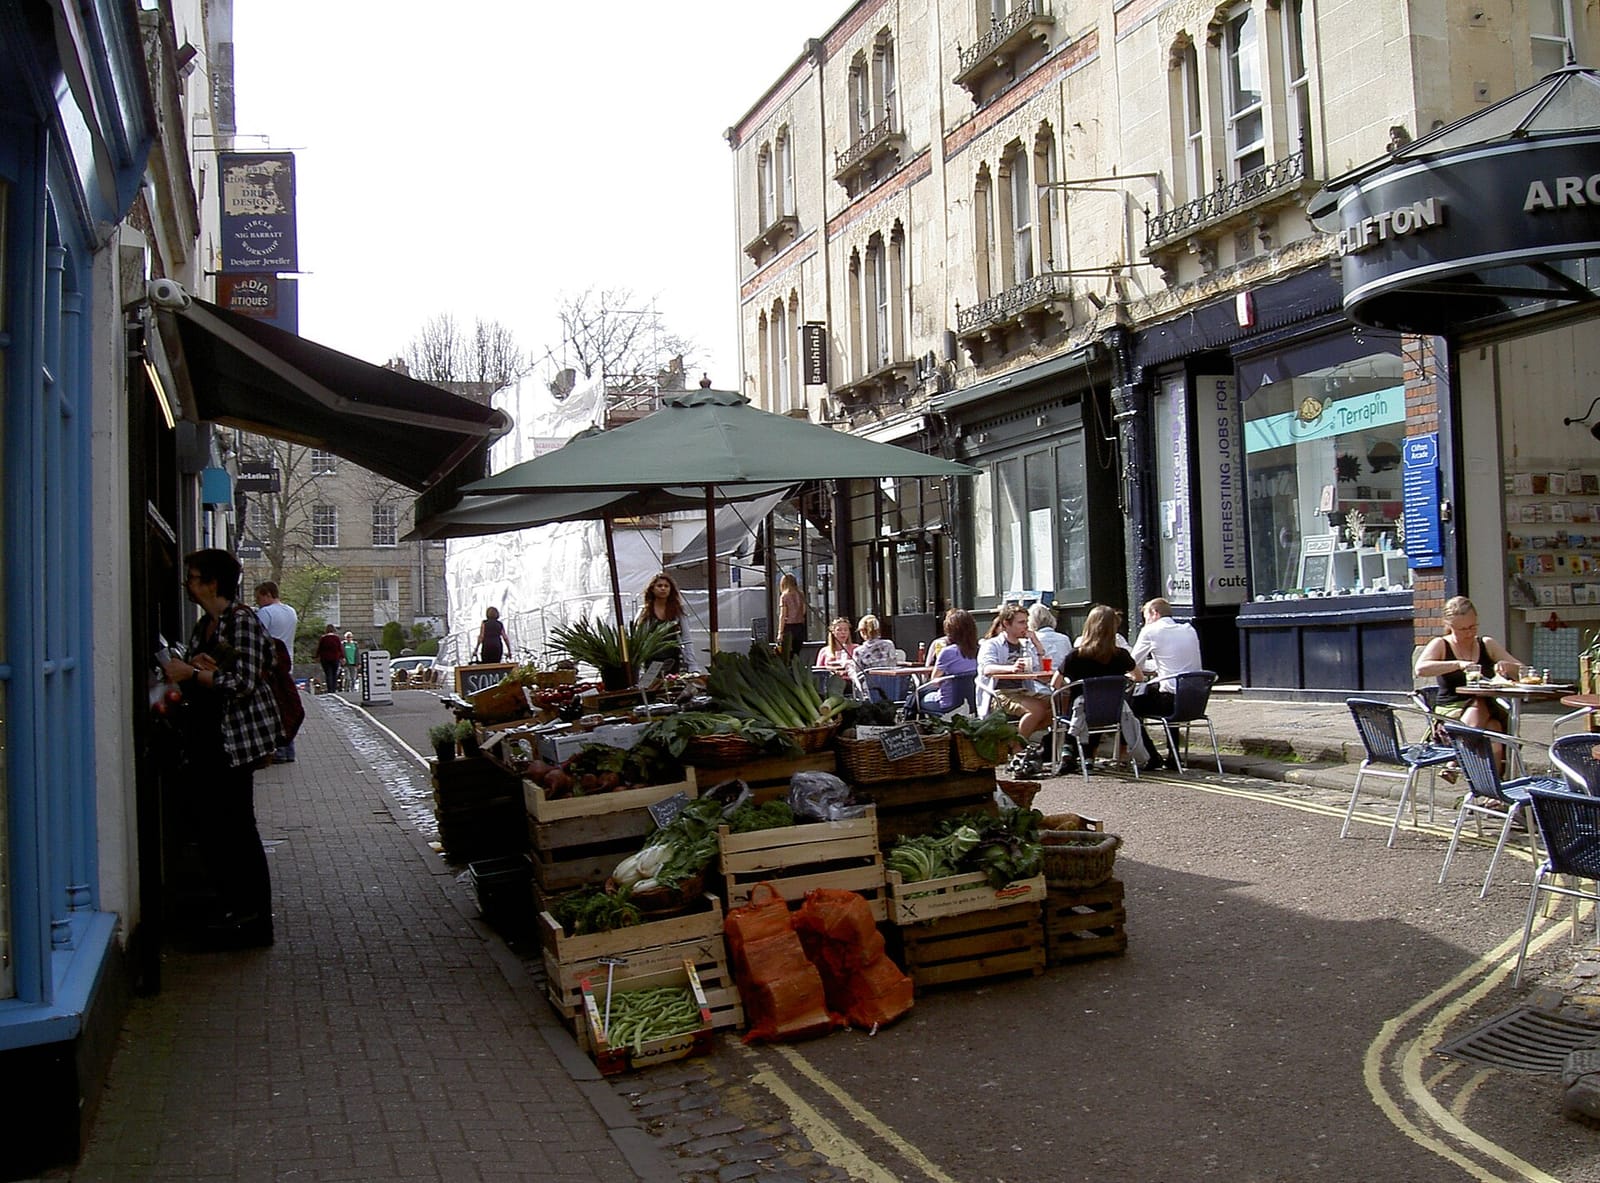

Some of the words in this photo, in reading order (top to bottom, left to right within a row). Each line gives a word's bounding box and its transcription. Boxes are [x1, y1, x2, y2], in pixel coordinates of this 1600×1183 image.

[243, 219, 274, 231] CIRCLE
[1336, 197, 1441, 257] CLIFTON
[241, 240, 279, 256] WORKSHOP
[230, 258, 261, 266] Designer
[262, 257, 291, 266] Jeweller
[810, 328, 821, 383] Bauhinia
[1216, 380, 1228, 411] FOR
[1336, 393, 1388, 428] Terrapin
[1217, 417, 1230, 458] JOBS
[1410, 444, 1428, 452] Clifton
[1411, 451, 1429, 459] Arcade
[1220, 463, 1235, 569] INTERESTING
[1171, 577, 1190, 590] cute
[1218, 575, 1247, 587] cute
[467, 671, 508, 694] SOM
